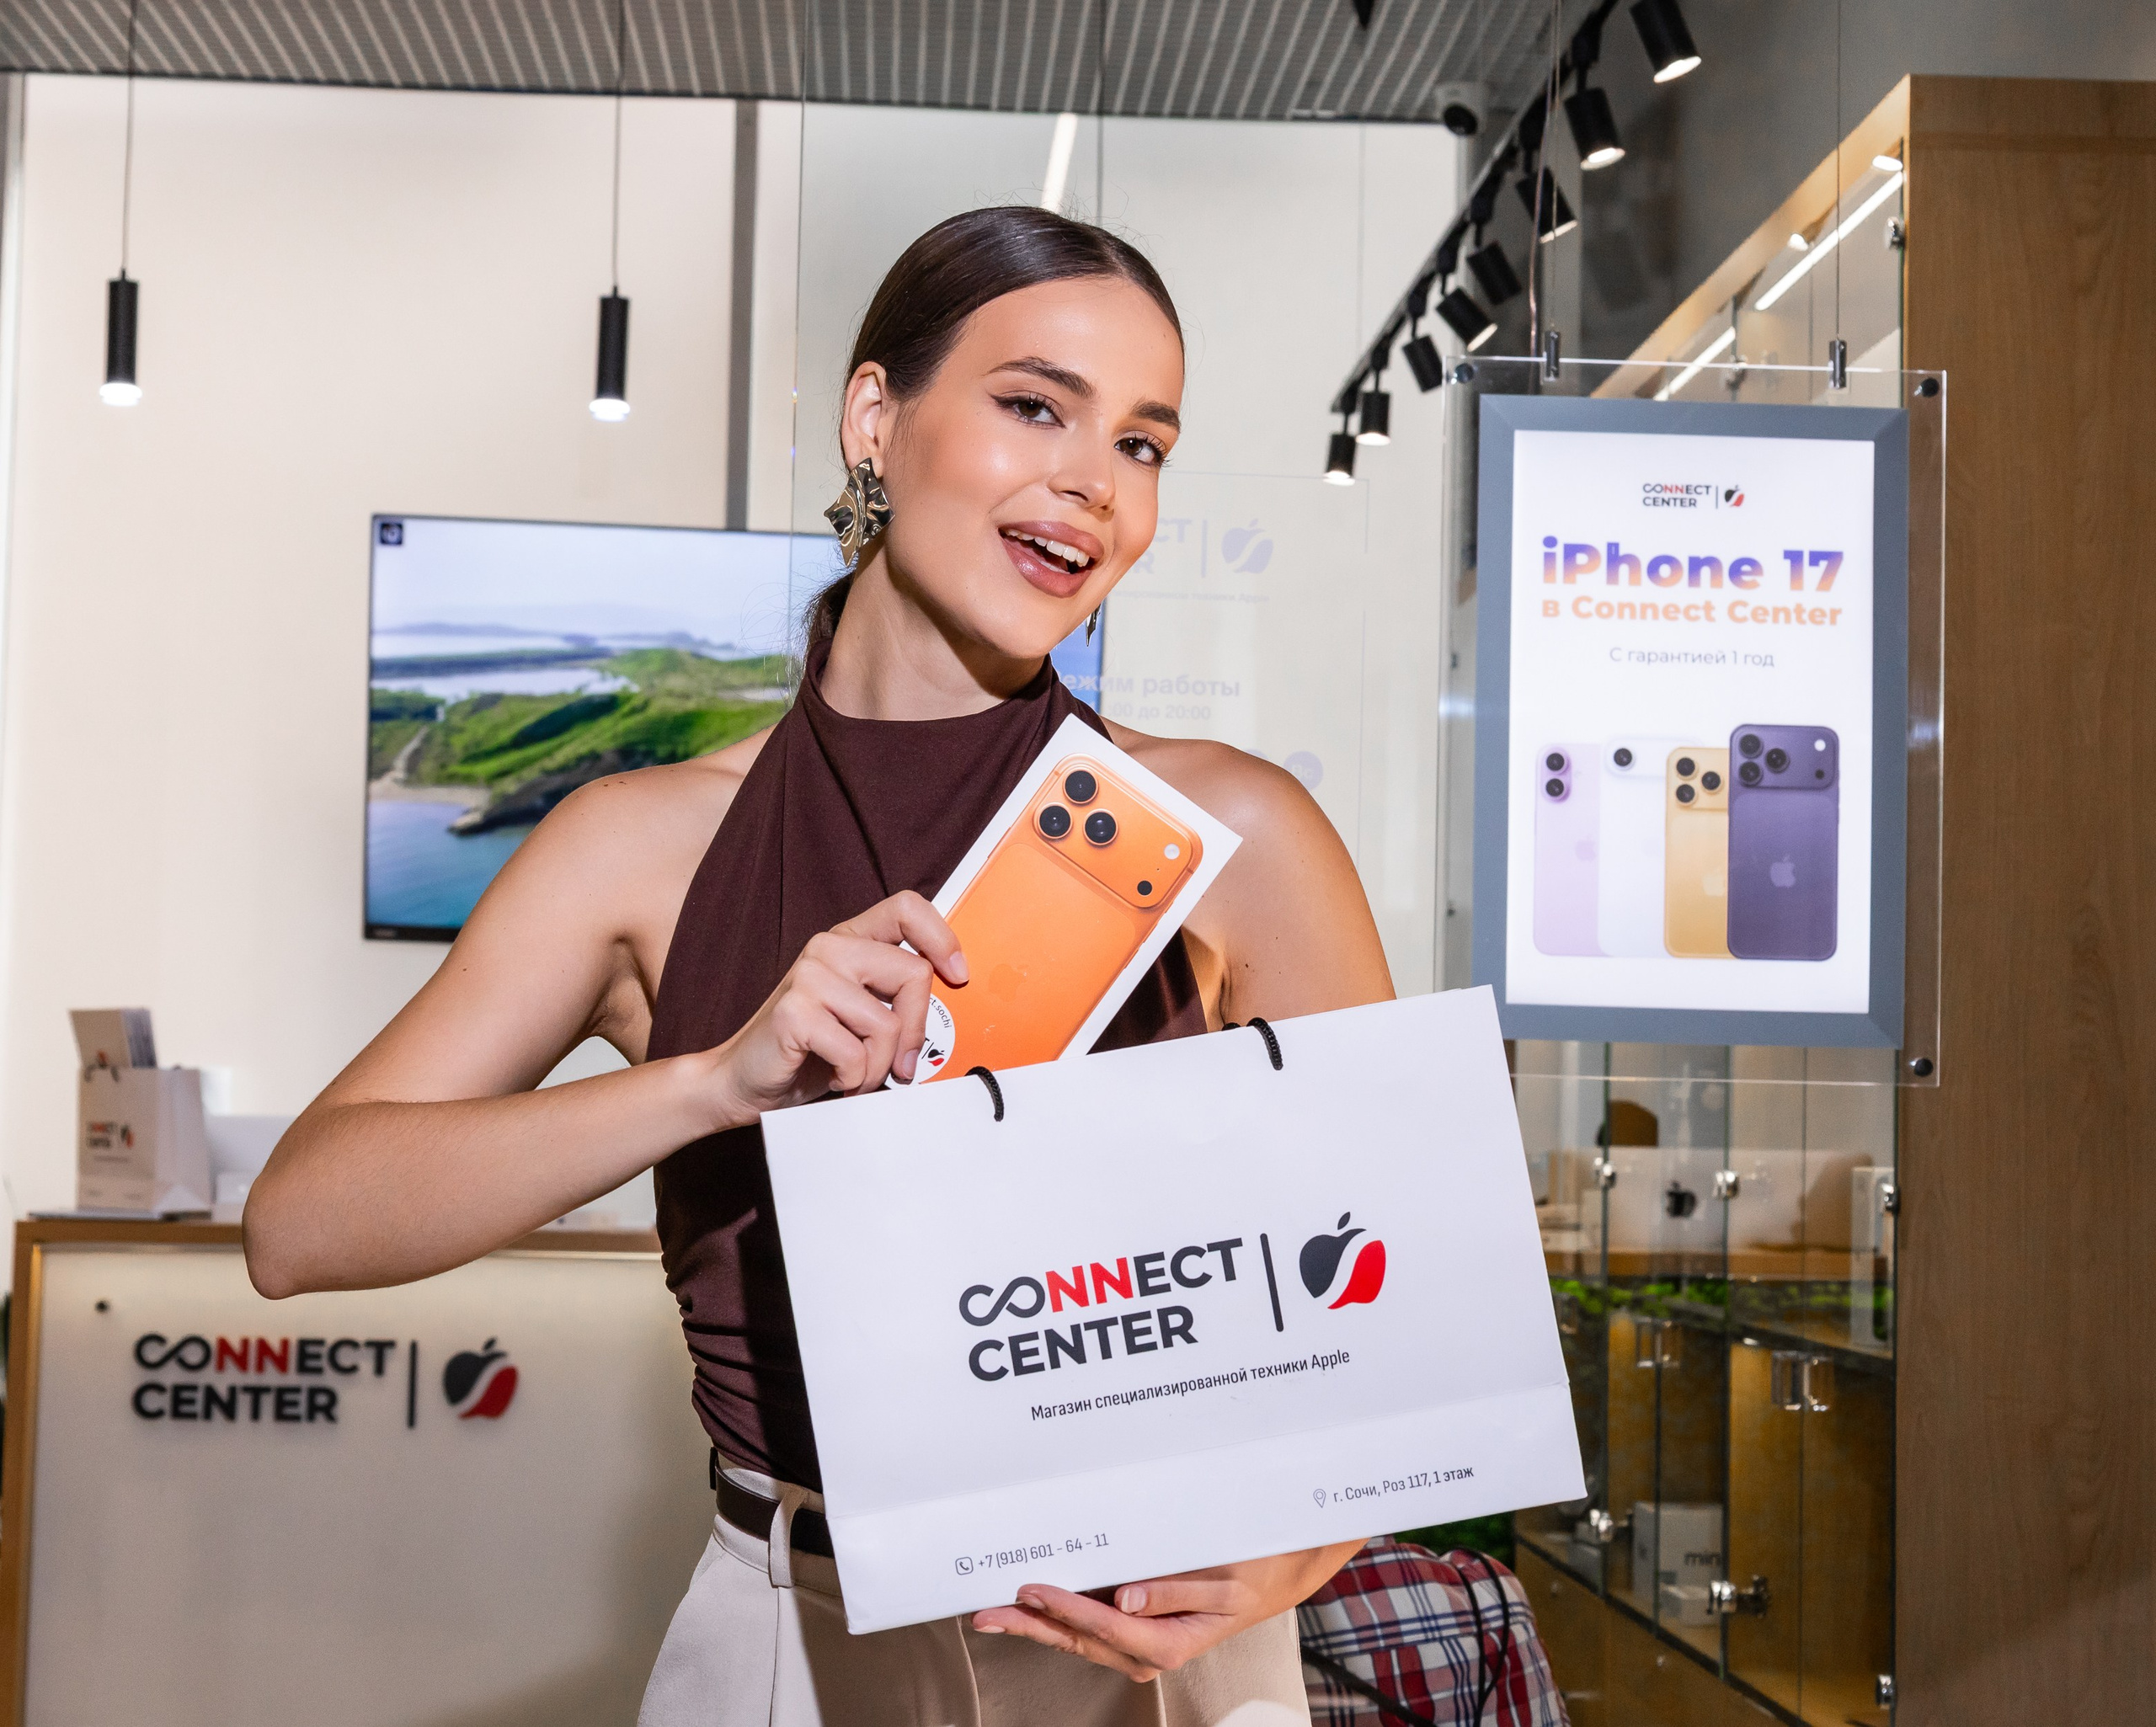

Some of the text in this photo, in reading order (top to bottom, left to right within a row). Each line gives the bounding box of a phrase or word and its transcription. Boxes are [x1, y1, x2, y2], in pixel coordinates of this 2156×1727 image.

[1642, 482, 1712, 496] CONNECT
[1642, 496, 1697, 508] CENTER
[1542, 536, 1844, 592] iPhone 17
[1541, 595, 1843, 626] в Connect Center
[1609, 646, 1775, 668] С гарантией 1 год
[1058, 672, 1240, 698] ежим работы
[1165, 705, 1212, 721] 20:00
[958, 1237, 1244, 1327] CONNECT
[132, 1332, 397, 1378] CONNECT
[968, 1304, 1199, 1383] CENTER
[131, 1381, 338, 1424] CENTER
[1031, 1349, 1351, 1421] Магазин специализированной техники Apple
[1332, 1467, 1475, 1503] г. Сочи, Роз 117, 1 этаж
[978, 1554, 993, 1569] +7
[996, 1548, 1028, 1569] (918)
[1030, 1543, 1054, 1559] 601
[1065, 1538, 1083, 1554] 64
[1094, 1532, 1109, 1548] 11
